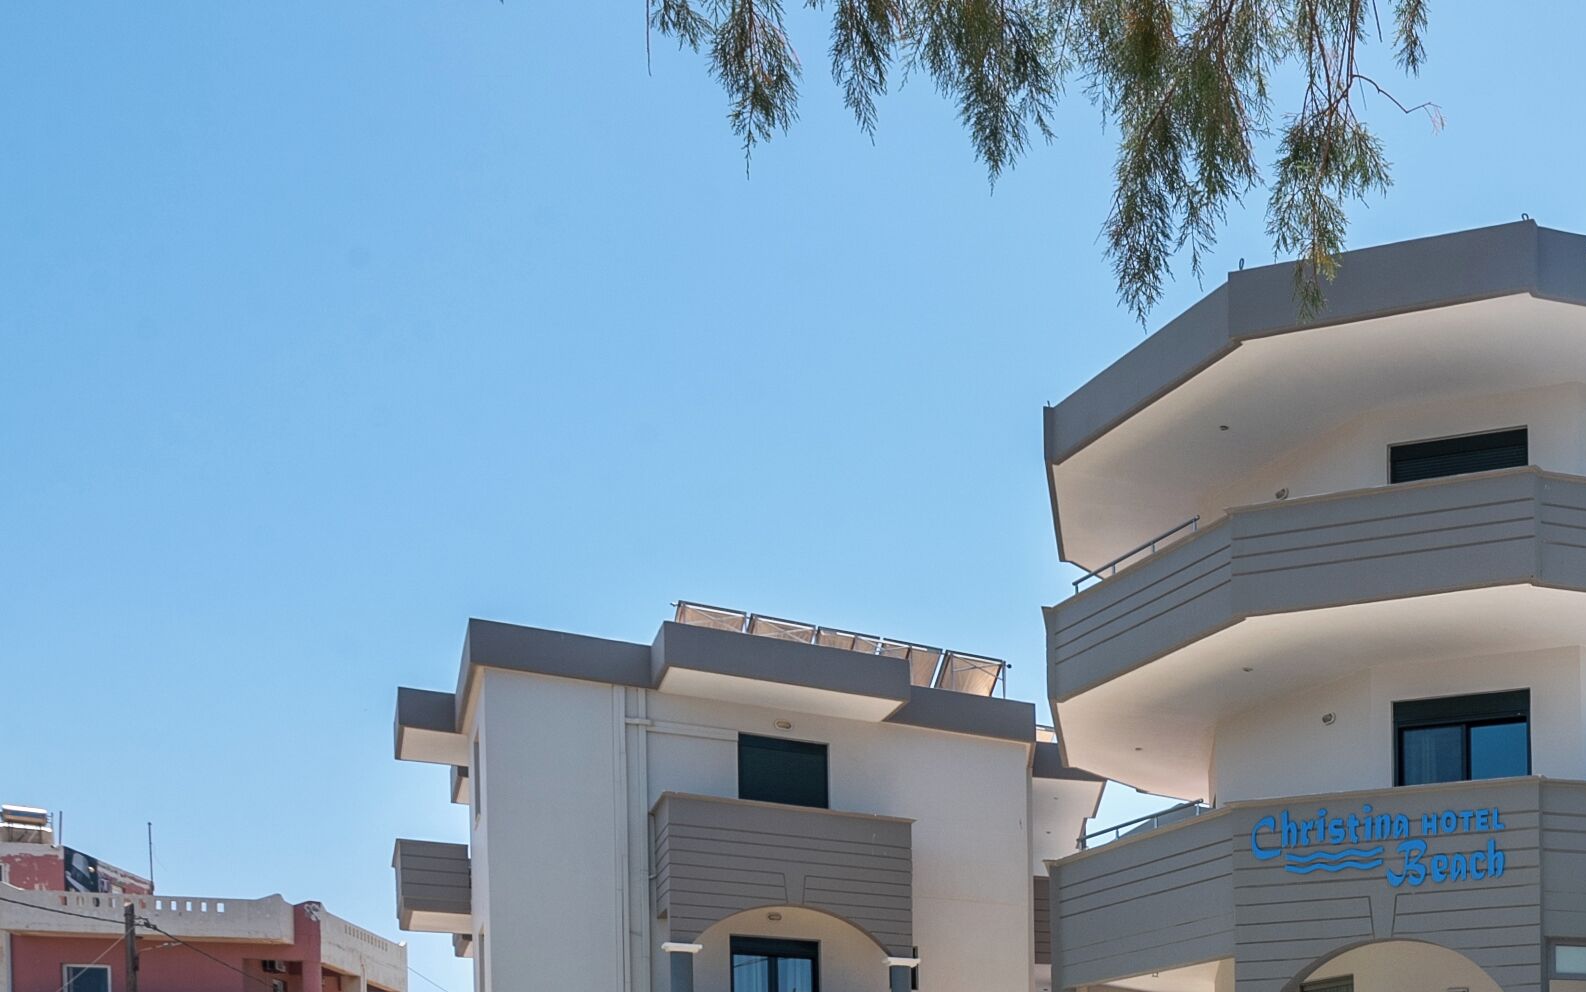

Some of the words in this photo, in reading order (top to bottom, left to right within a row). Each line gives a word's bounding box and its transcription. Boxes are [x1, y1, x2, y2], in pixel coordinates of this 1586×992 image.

[1251, 805, 1409, 860] Christina
[1421, 808, 1506, 836] HOTEL
[1386, 839, 1505, 887] Beach
